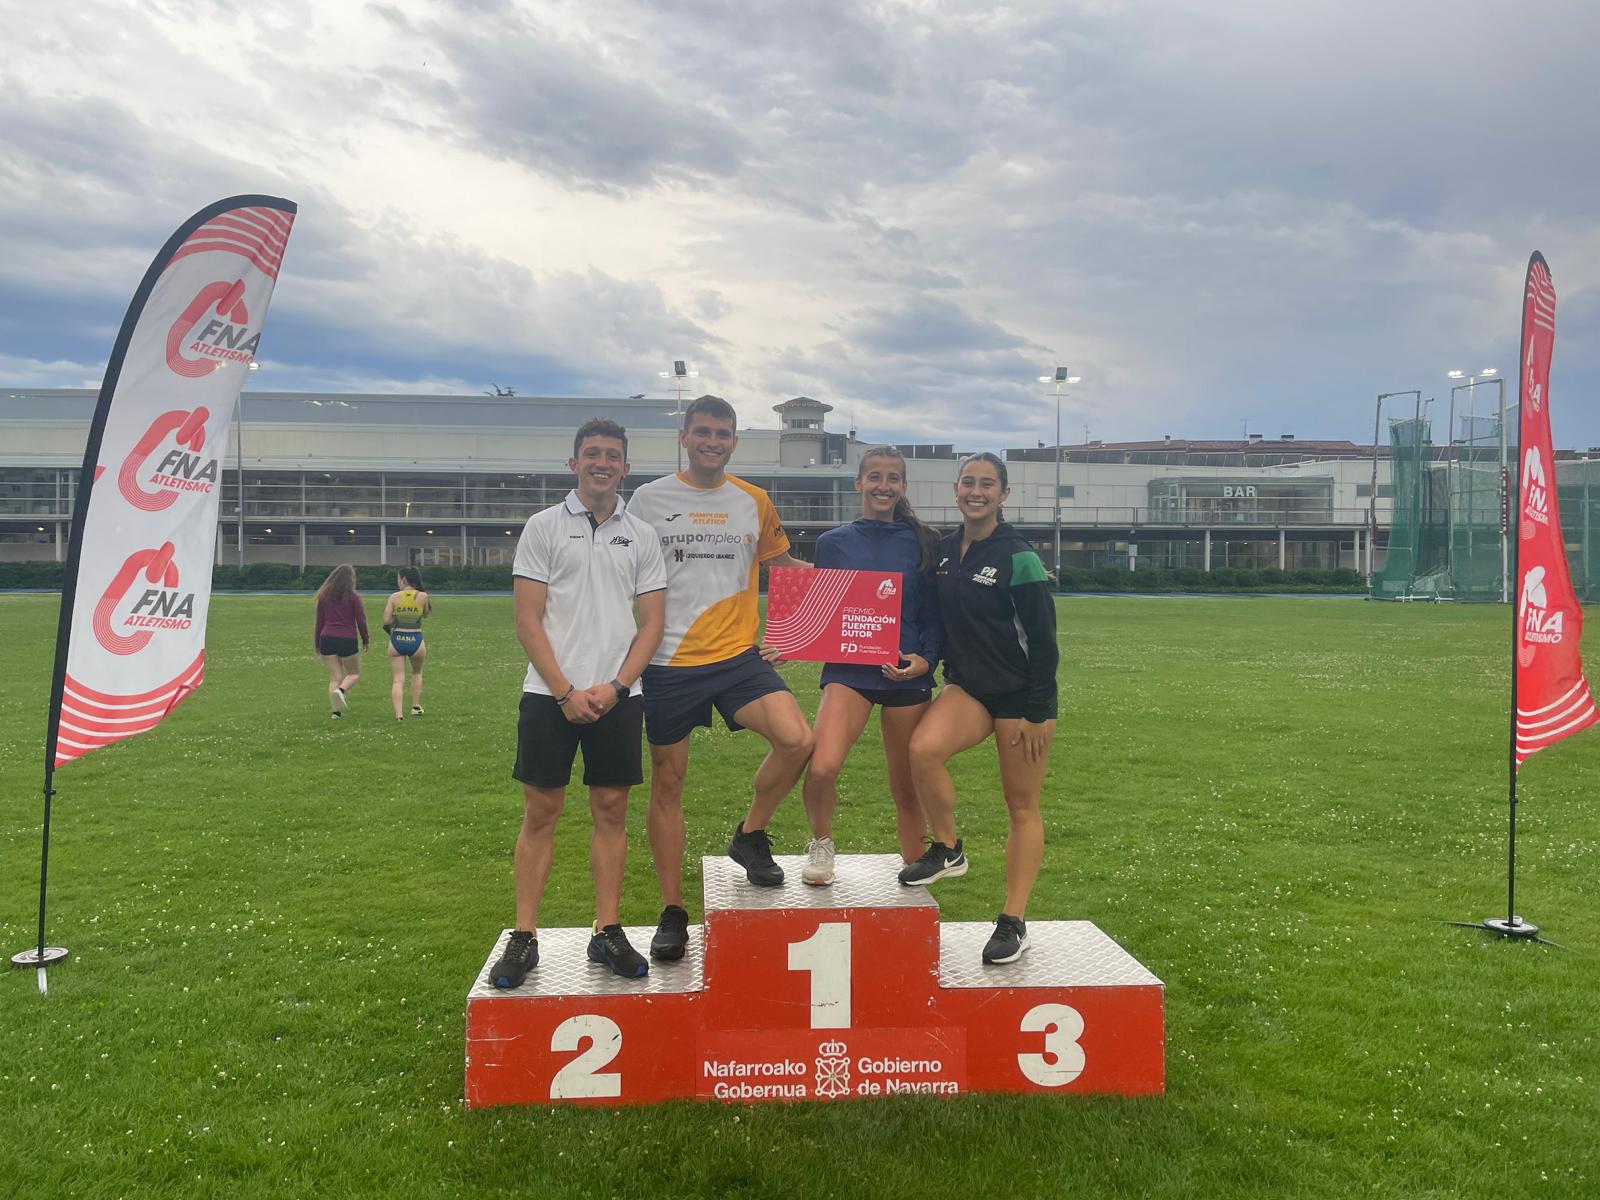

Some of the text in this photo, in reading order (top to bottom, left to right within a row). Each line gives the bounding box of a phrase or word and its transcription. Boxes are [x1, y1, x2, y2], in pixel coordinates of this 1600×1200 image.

[197, 319, 261, 355] FNA
[156, 449, 217, 483] FNA
[1223, 486, 1256, 497] BAR
[662, 533, 741, 545] grupompleo
[980, 566, 997, 578] PA
[130, 589, 195, 618] FNA
[843, 606, 875, 615] PREMIO
[123, 615, 192, 630] ATLETISMO
[841, 622, 882, 631] FUENTES
[842, 614, 896, 624] FUNDACIÓN
[1526, 607, 1563, 633] FNA
[841, 630, 873, 638] DUTOR
[787, 922, 852, 1029] 1
[1017, 1003, 1086, 1088] 3
[550, 1014, 623, 1099] 2
[703, 1061, 807, 1077] Nafarroako
[857, 1057, 942, 1075] Gobierno
[714, 1083, 807, 1100] Gobernua
[857, 1079, 960, 1096] de Navarra
